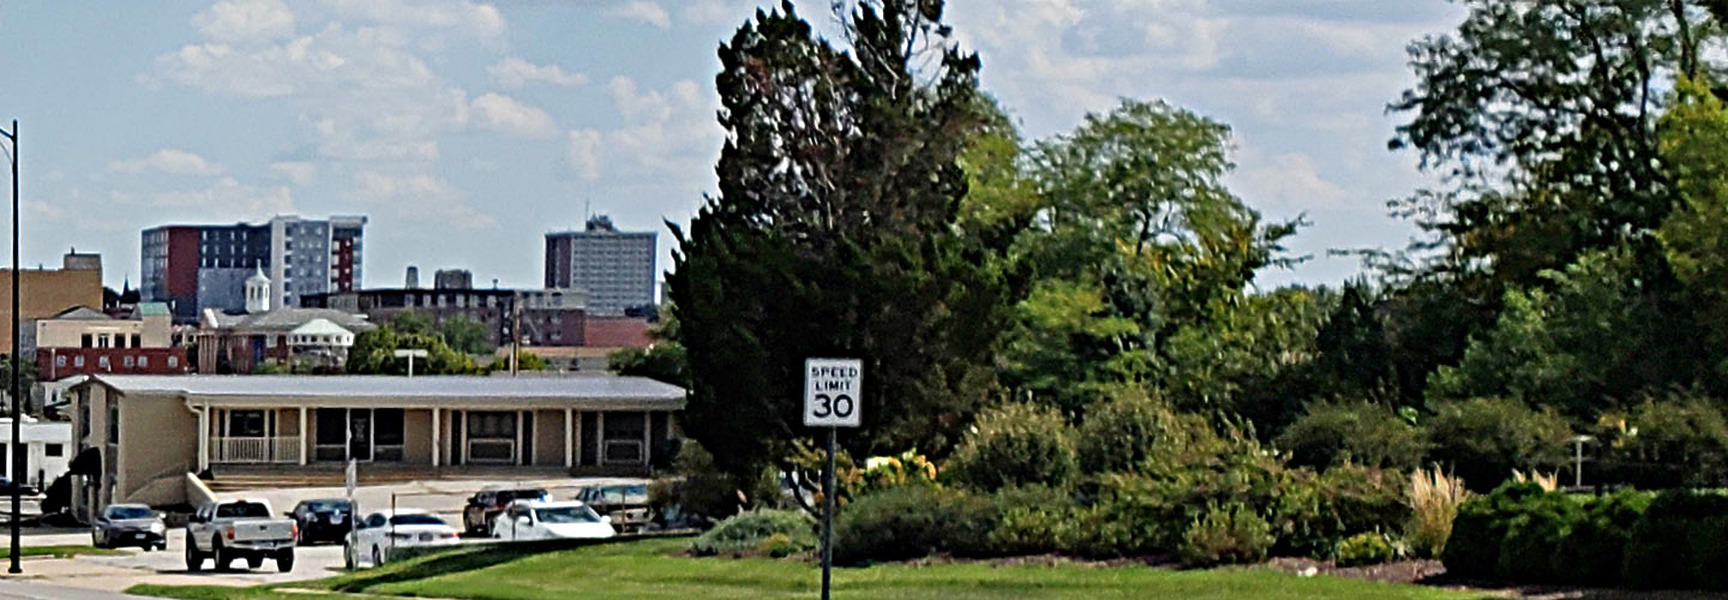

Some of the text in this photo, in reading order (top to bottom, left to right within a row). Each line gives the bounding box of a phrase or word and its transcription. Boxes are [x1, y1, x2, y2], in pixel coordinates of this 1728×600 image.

[812, 366, 858, 378] SPEED
[815, 380, 851, 391] LIMIT
[813, 393, 854, 418] 30
